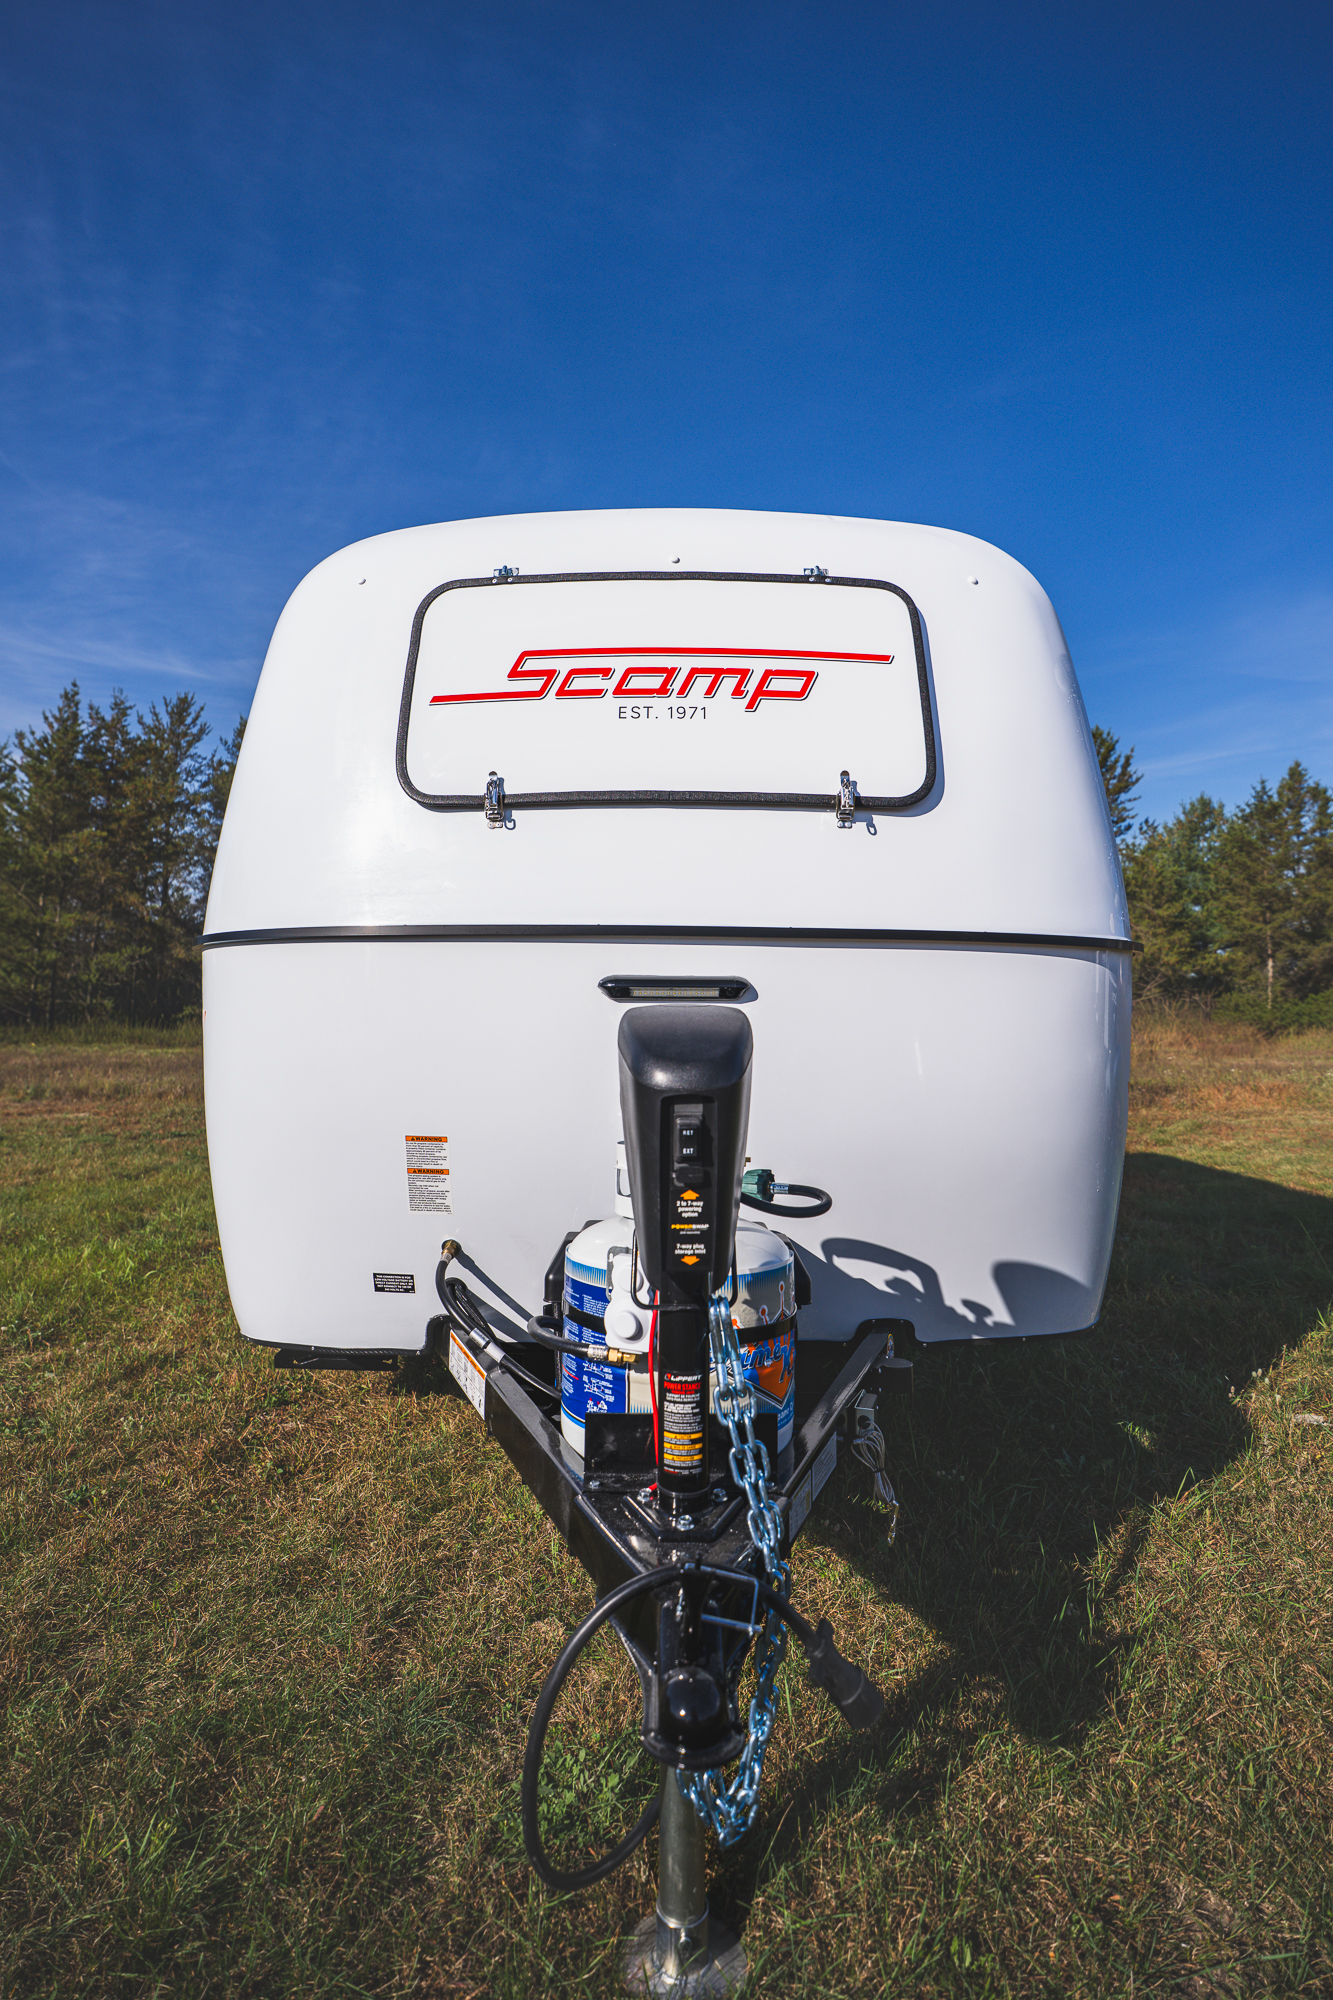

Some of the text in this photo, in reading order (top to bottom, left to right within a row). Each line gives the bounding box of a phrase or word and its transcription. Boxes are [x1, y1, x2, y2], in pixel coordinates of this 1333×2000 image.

[429, 646, 895, 712] Scamp
[618, 706, 708, 719] EST. 1971
[663, 1380, 681, 1391] POWER
